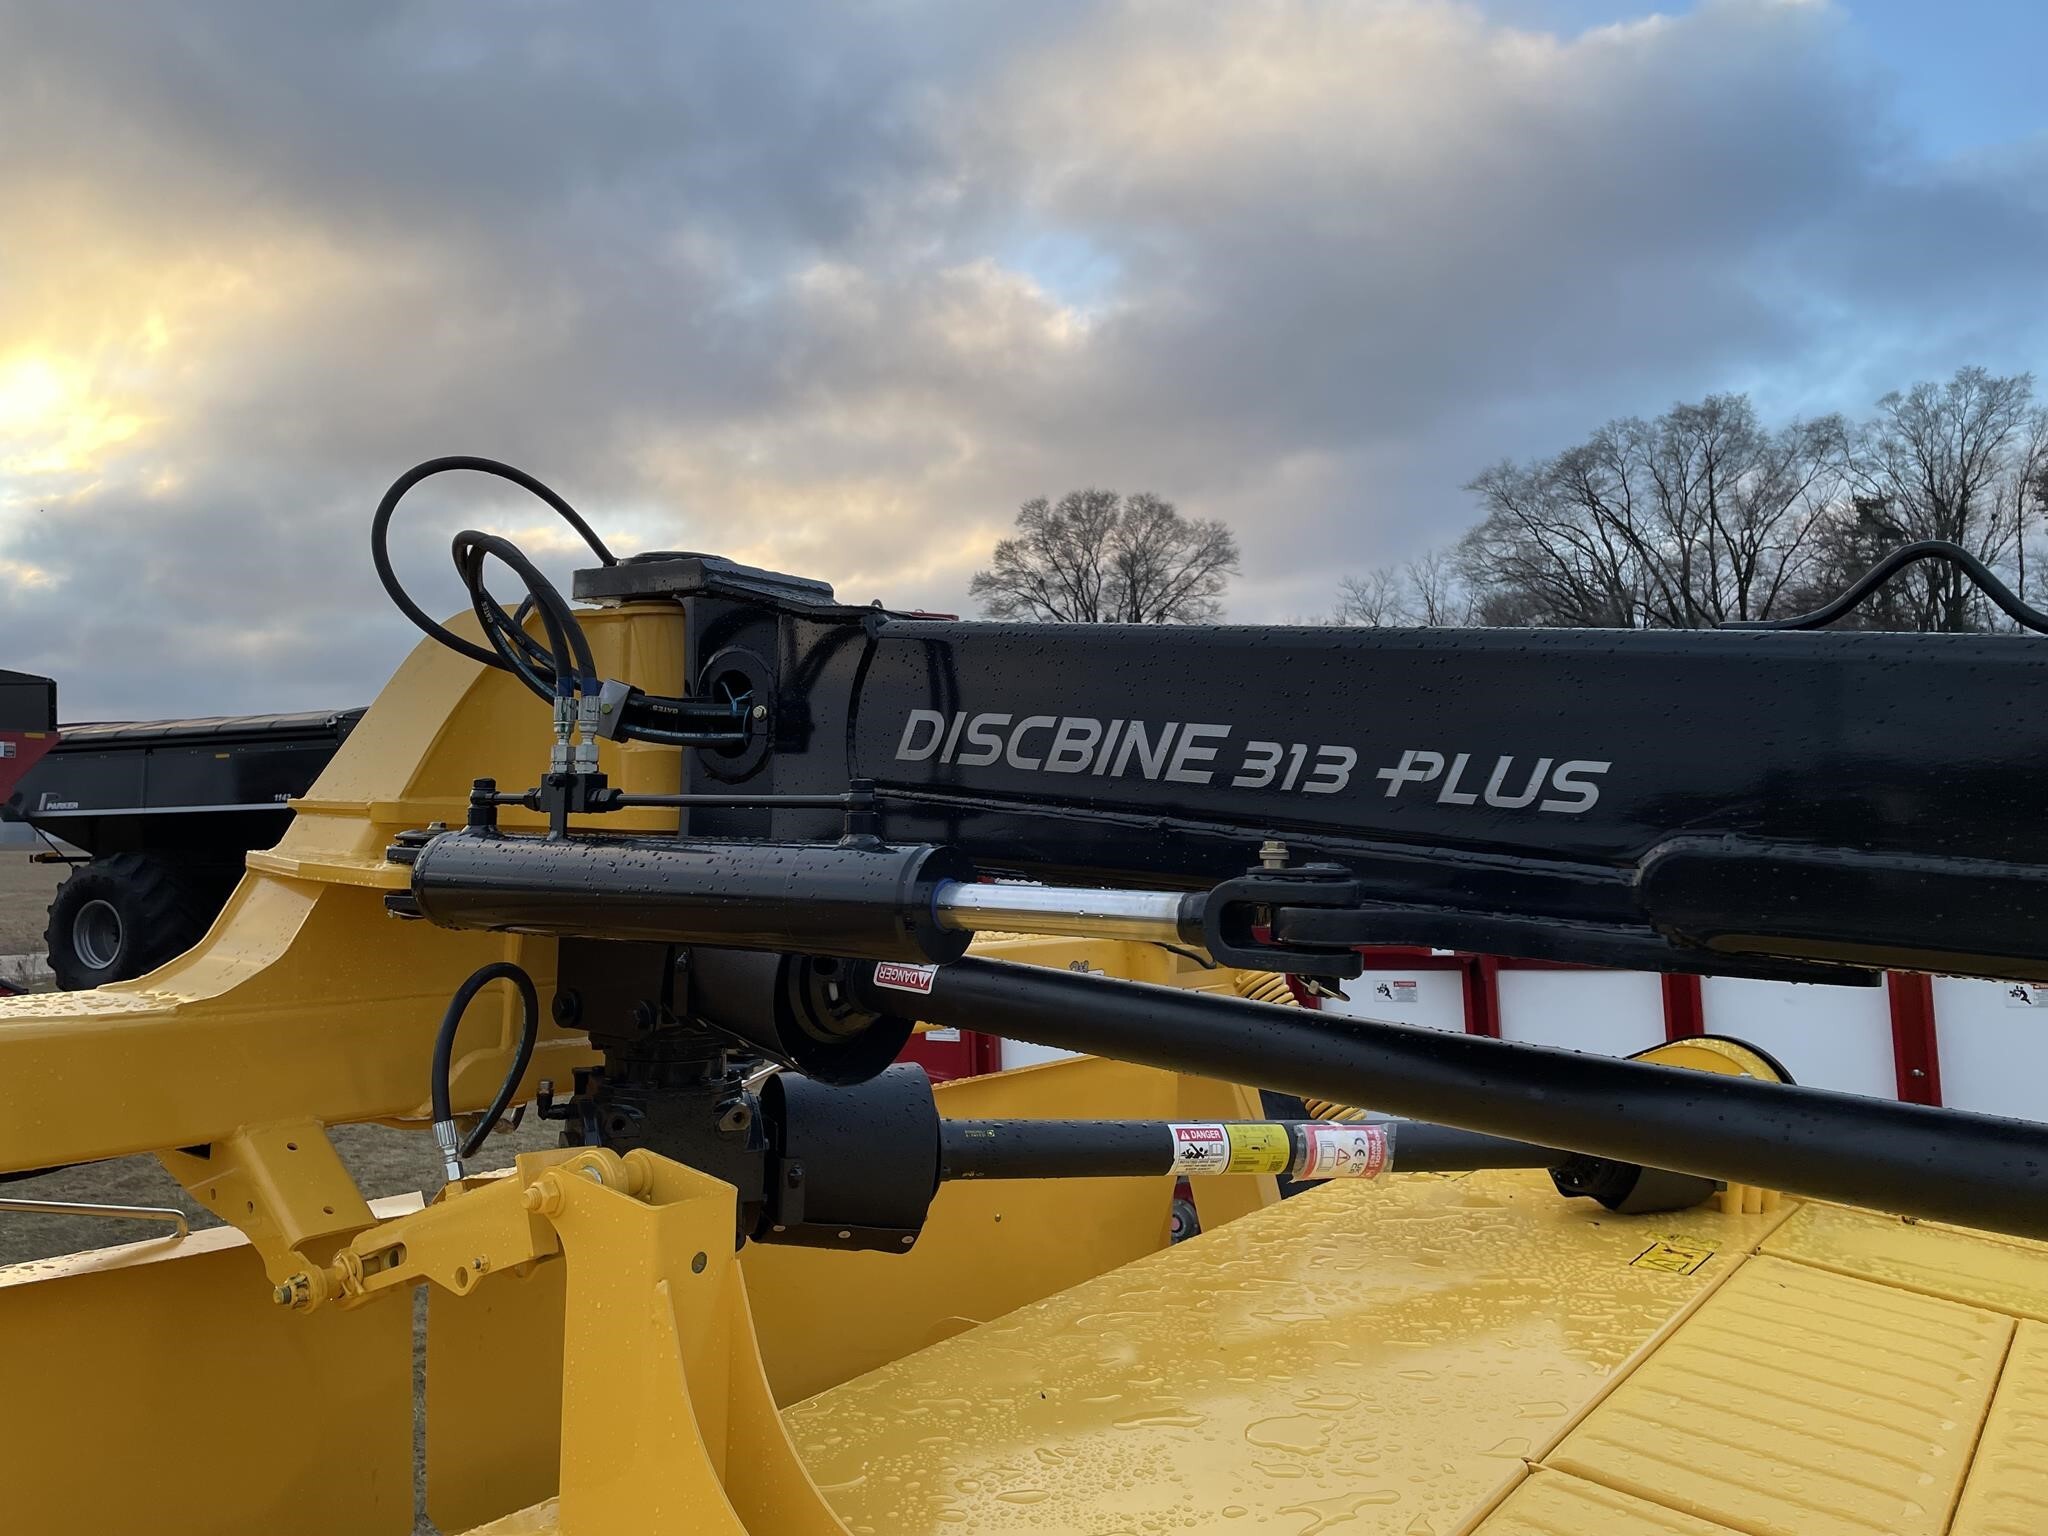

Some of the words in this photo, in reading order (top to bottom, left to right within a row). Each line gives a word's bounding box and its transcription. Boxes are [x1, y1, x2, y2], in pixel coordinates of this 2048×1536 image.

[895, 709, 1232, 784] DISCBINE
[1232, 741, 1358, 794] 313
[46, 801, 79, 810] PARKER
[879, 967, 918, 984] DANGER
[1190, 1130, 1221, 1139] DANGER
